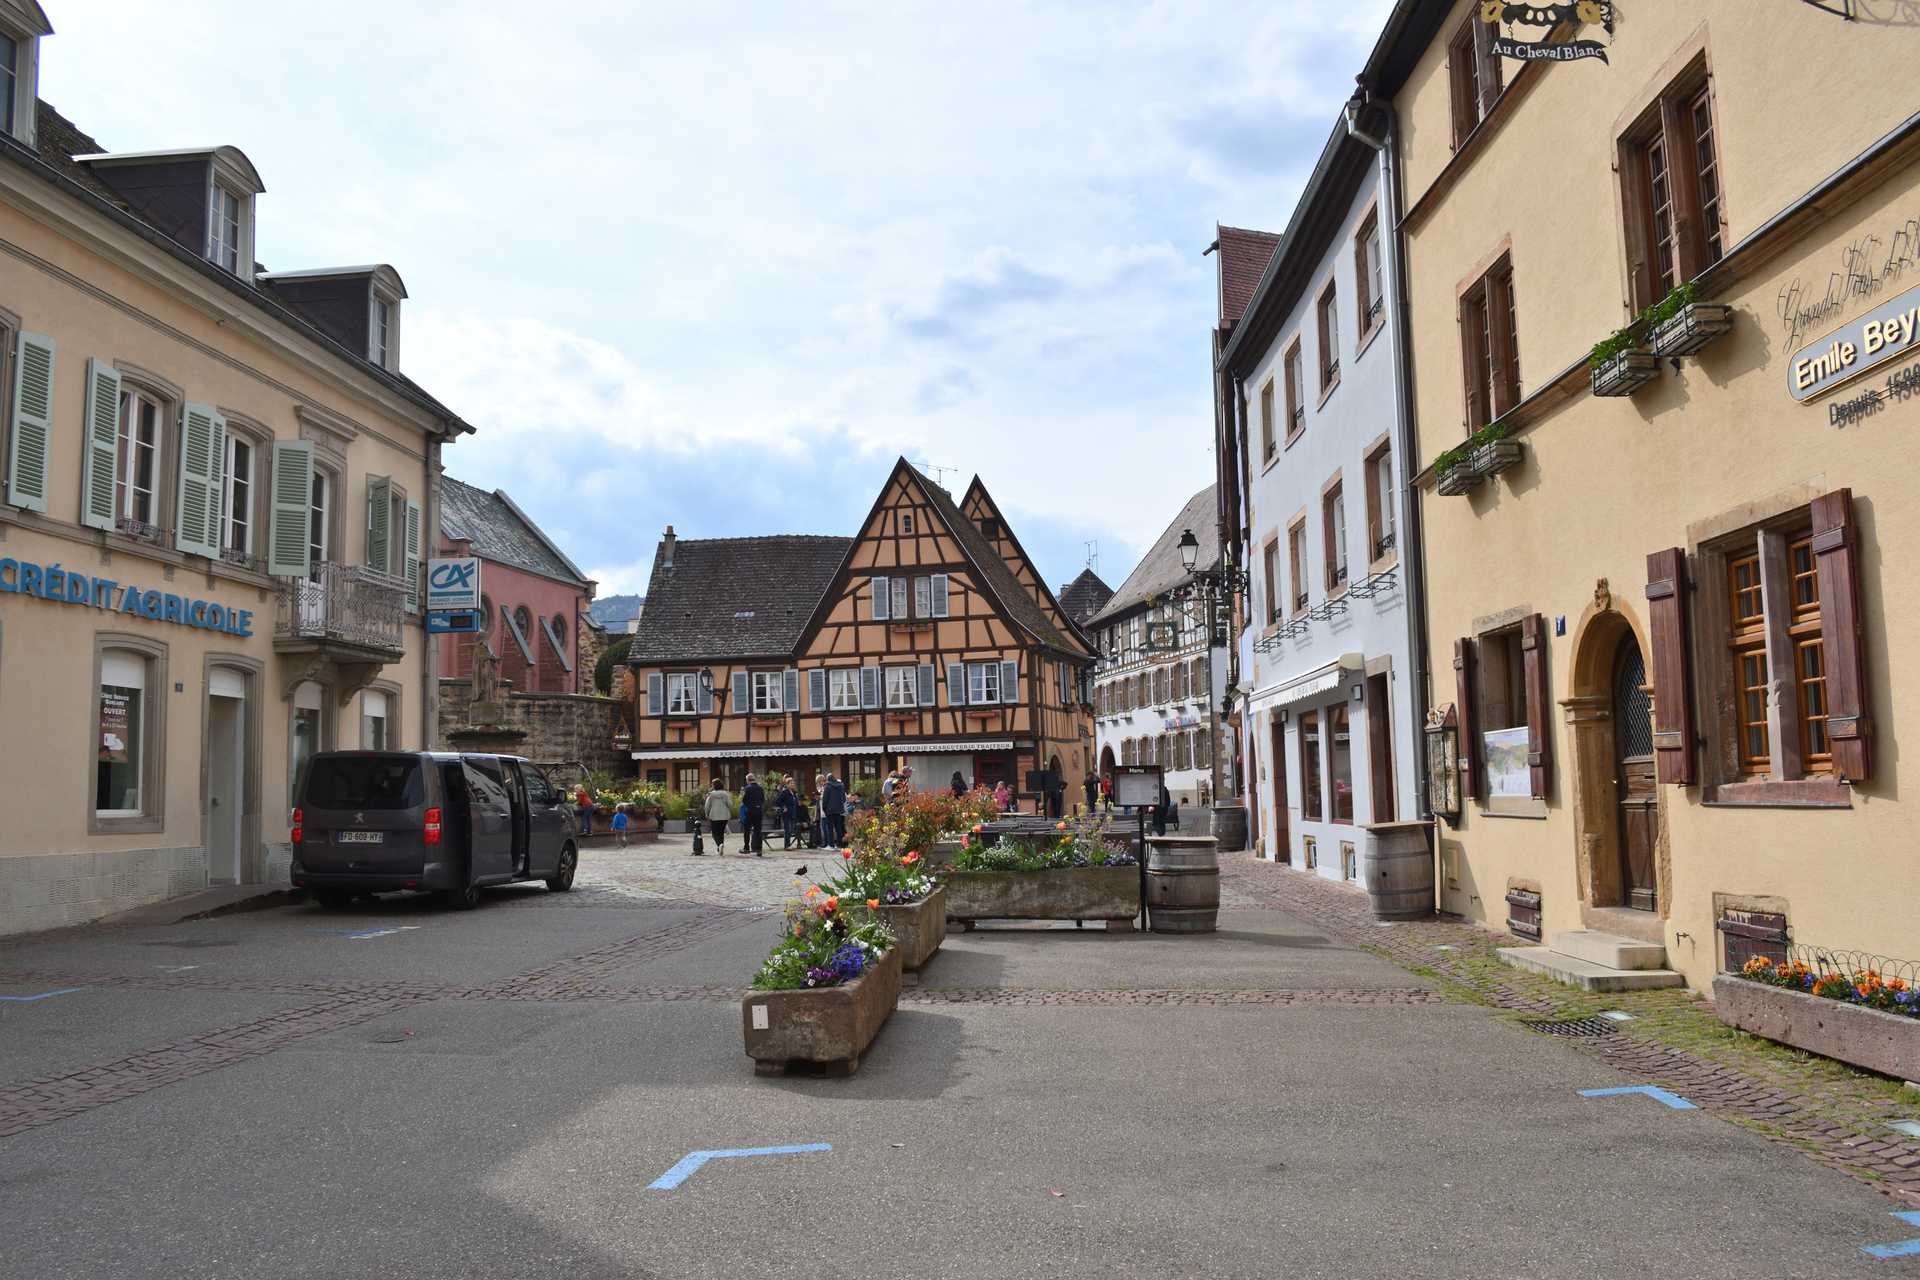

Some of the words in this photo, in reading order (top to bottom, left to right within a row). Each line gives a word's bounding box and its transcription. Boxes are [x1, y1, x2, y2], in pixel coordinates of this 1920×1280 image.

[1492, 41, 1511, 55] Au
[1515, 45, 1560, 59] Cheval
[1563, 45, 1602, 59] Blanc
[1795, 340, 1855, 390] Emile
[1863, 304, 1920, 356] Bey
[1829, 388, 1881, 426] Depuis
[430, 561, 475, 590] CA
[0, 557, 118, 610] CRÉDIT
[121, 585, 253, 638] AGRICOLE
[103, 707, 126, 716] OUVERT
